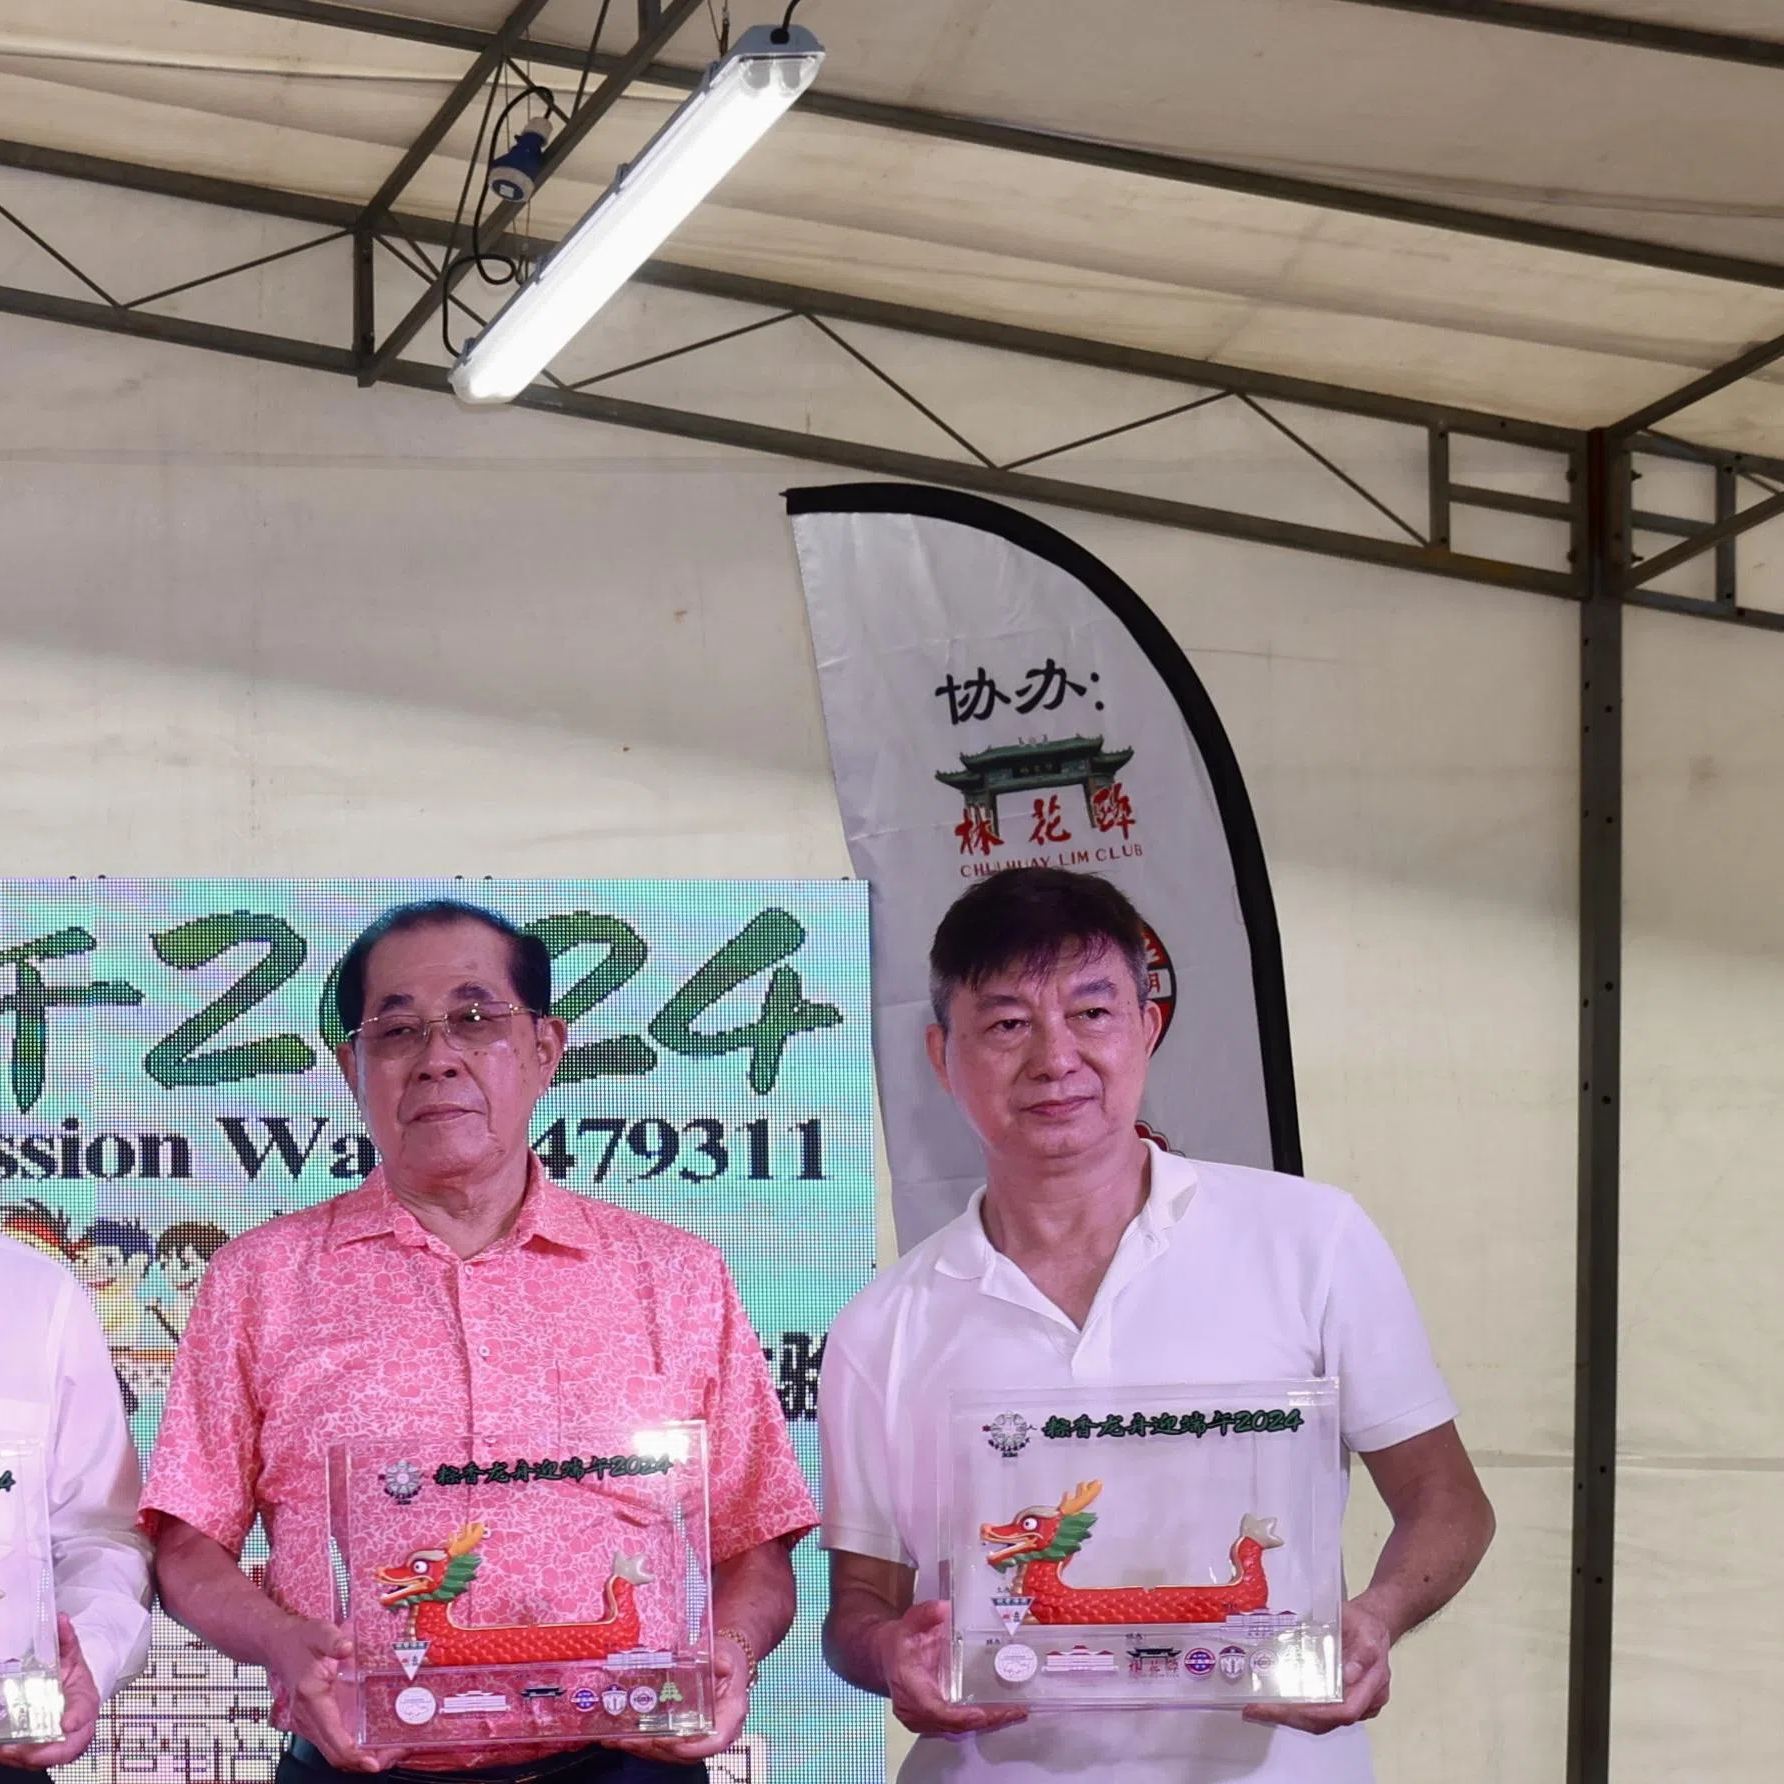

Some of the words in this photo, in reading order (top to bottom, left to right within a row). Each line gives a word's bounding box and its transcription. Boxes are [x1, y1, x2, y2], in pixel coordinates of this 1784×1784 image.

[936, 658, 1105, 725] 协办:
[1059, 851, 1089, 867] LIM
[1095, 844, 1143, 862] CLUB
[216, 1117, 379, 1183] Wa
[1041, 1408, 1305, 1439] 粽香龙舟迎端午2024
